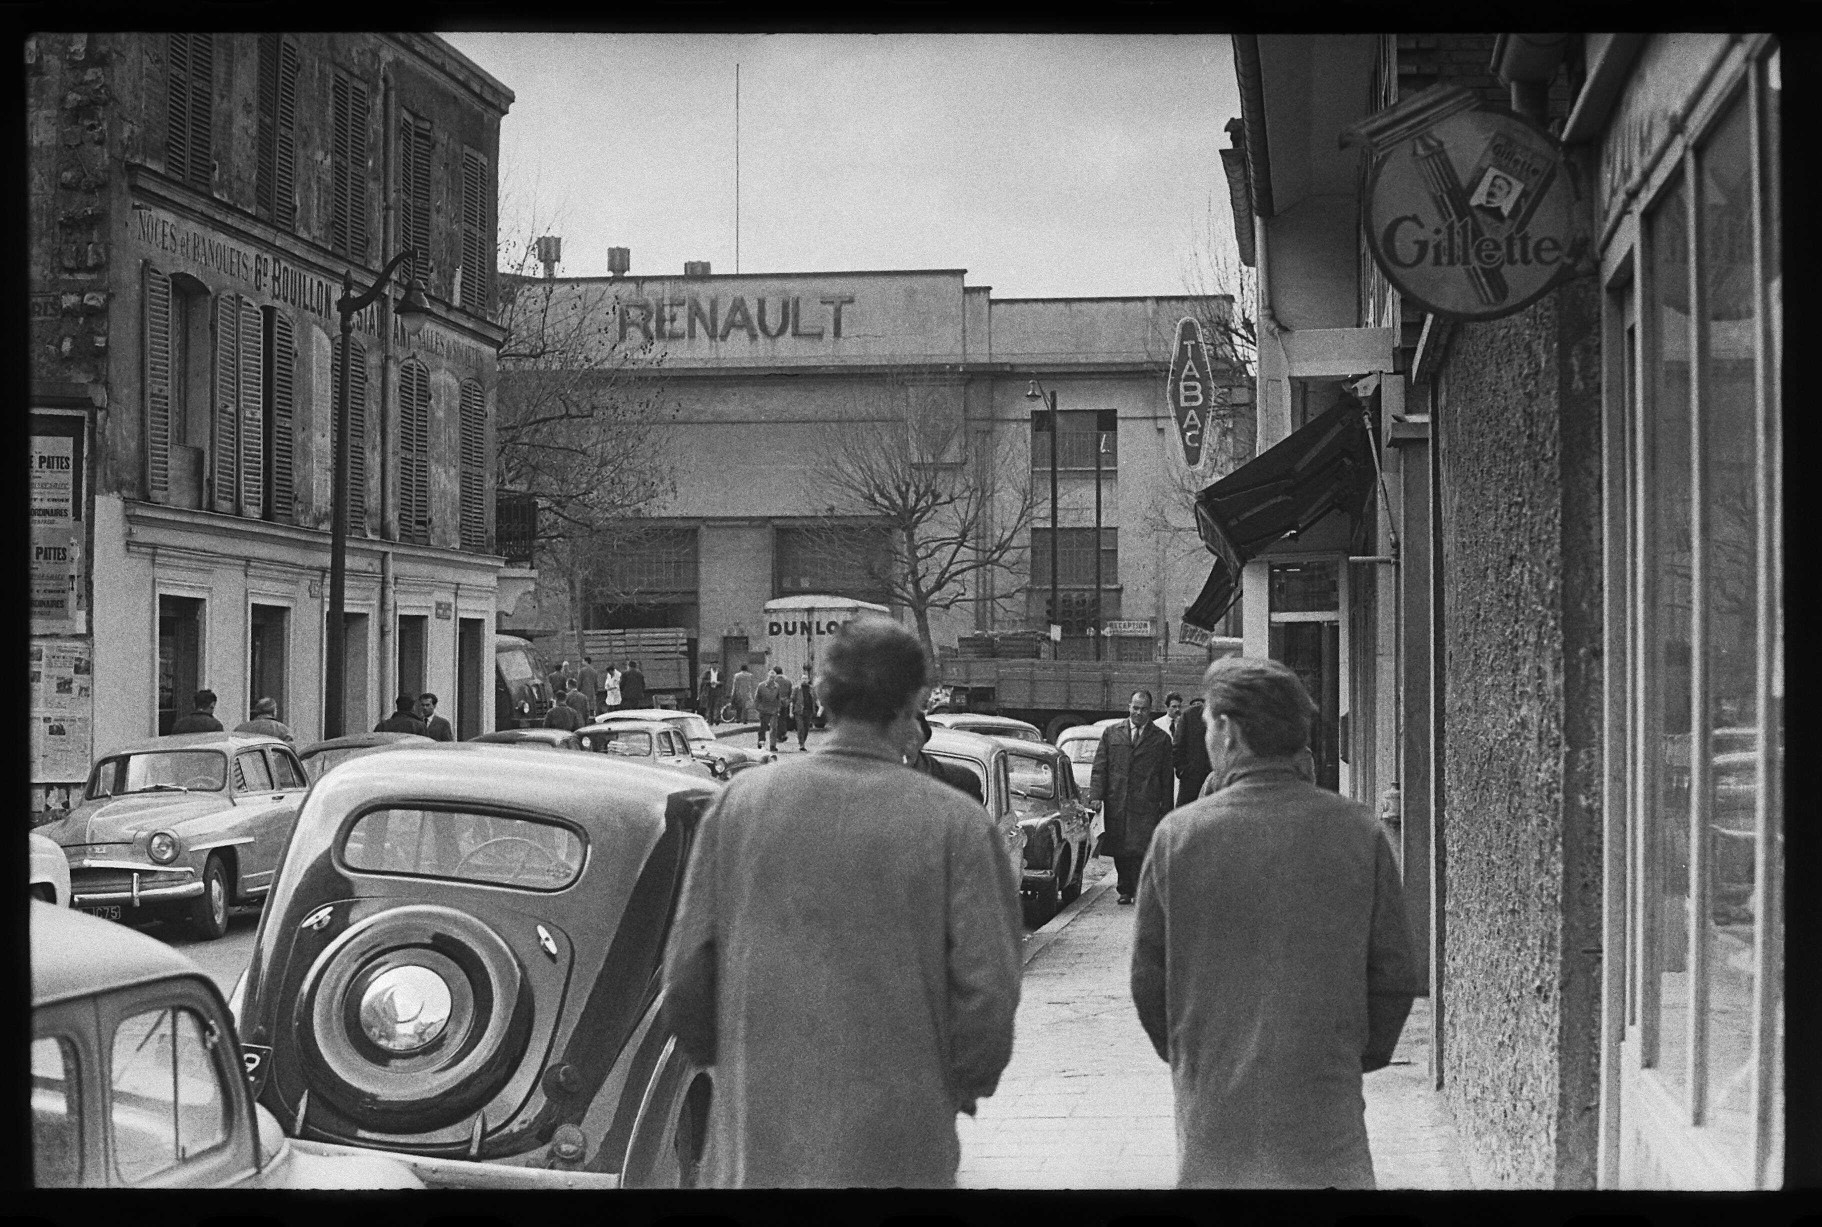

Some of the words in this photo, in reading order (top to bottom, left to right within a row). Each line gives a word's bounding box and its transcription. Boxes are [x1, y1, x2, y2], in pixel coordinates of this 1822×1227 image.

[1382, 213, 1563, 268] Gillette
[138, 210, 177, 253] NOCES
[180, 232, 190, 259] et
[193, 232, 248, 281] BANQUETS
[272, 257, 332, 319] BOUILLON
[618, 296, 855, 343] RENAULT
[1179, 340, 1204, 447] TABAC
[38, 455, 70, 469] PATTES
[35, 546, 67, 561] PATTES
[768, 620, 850, 636] DUNLO
